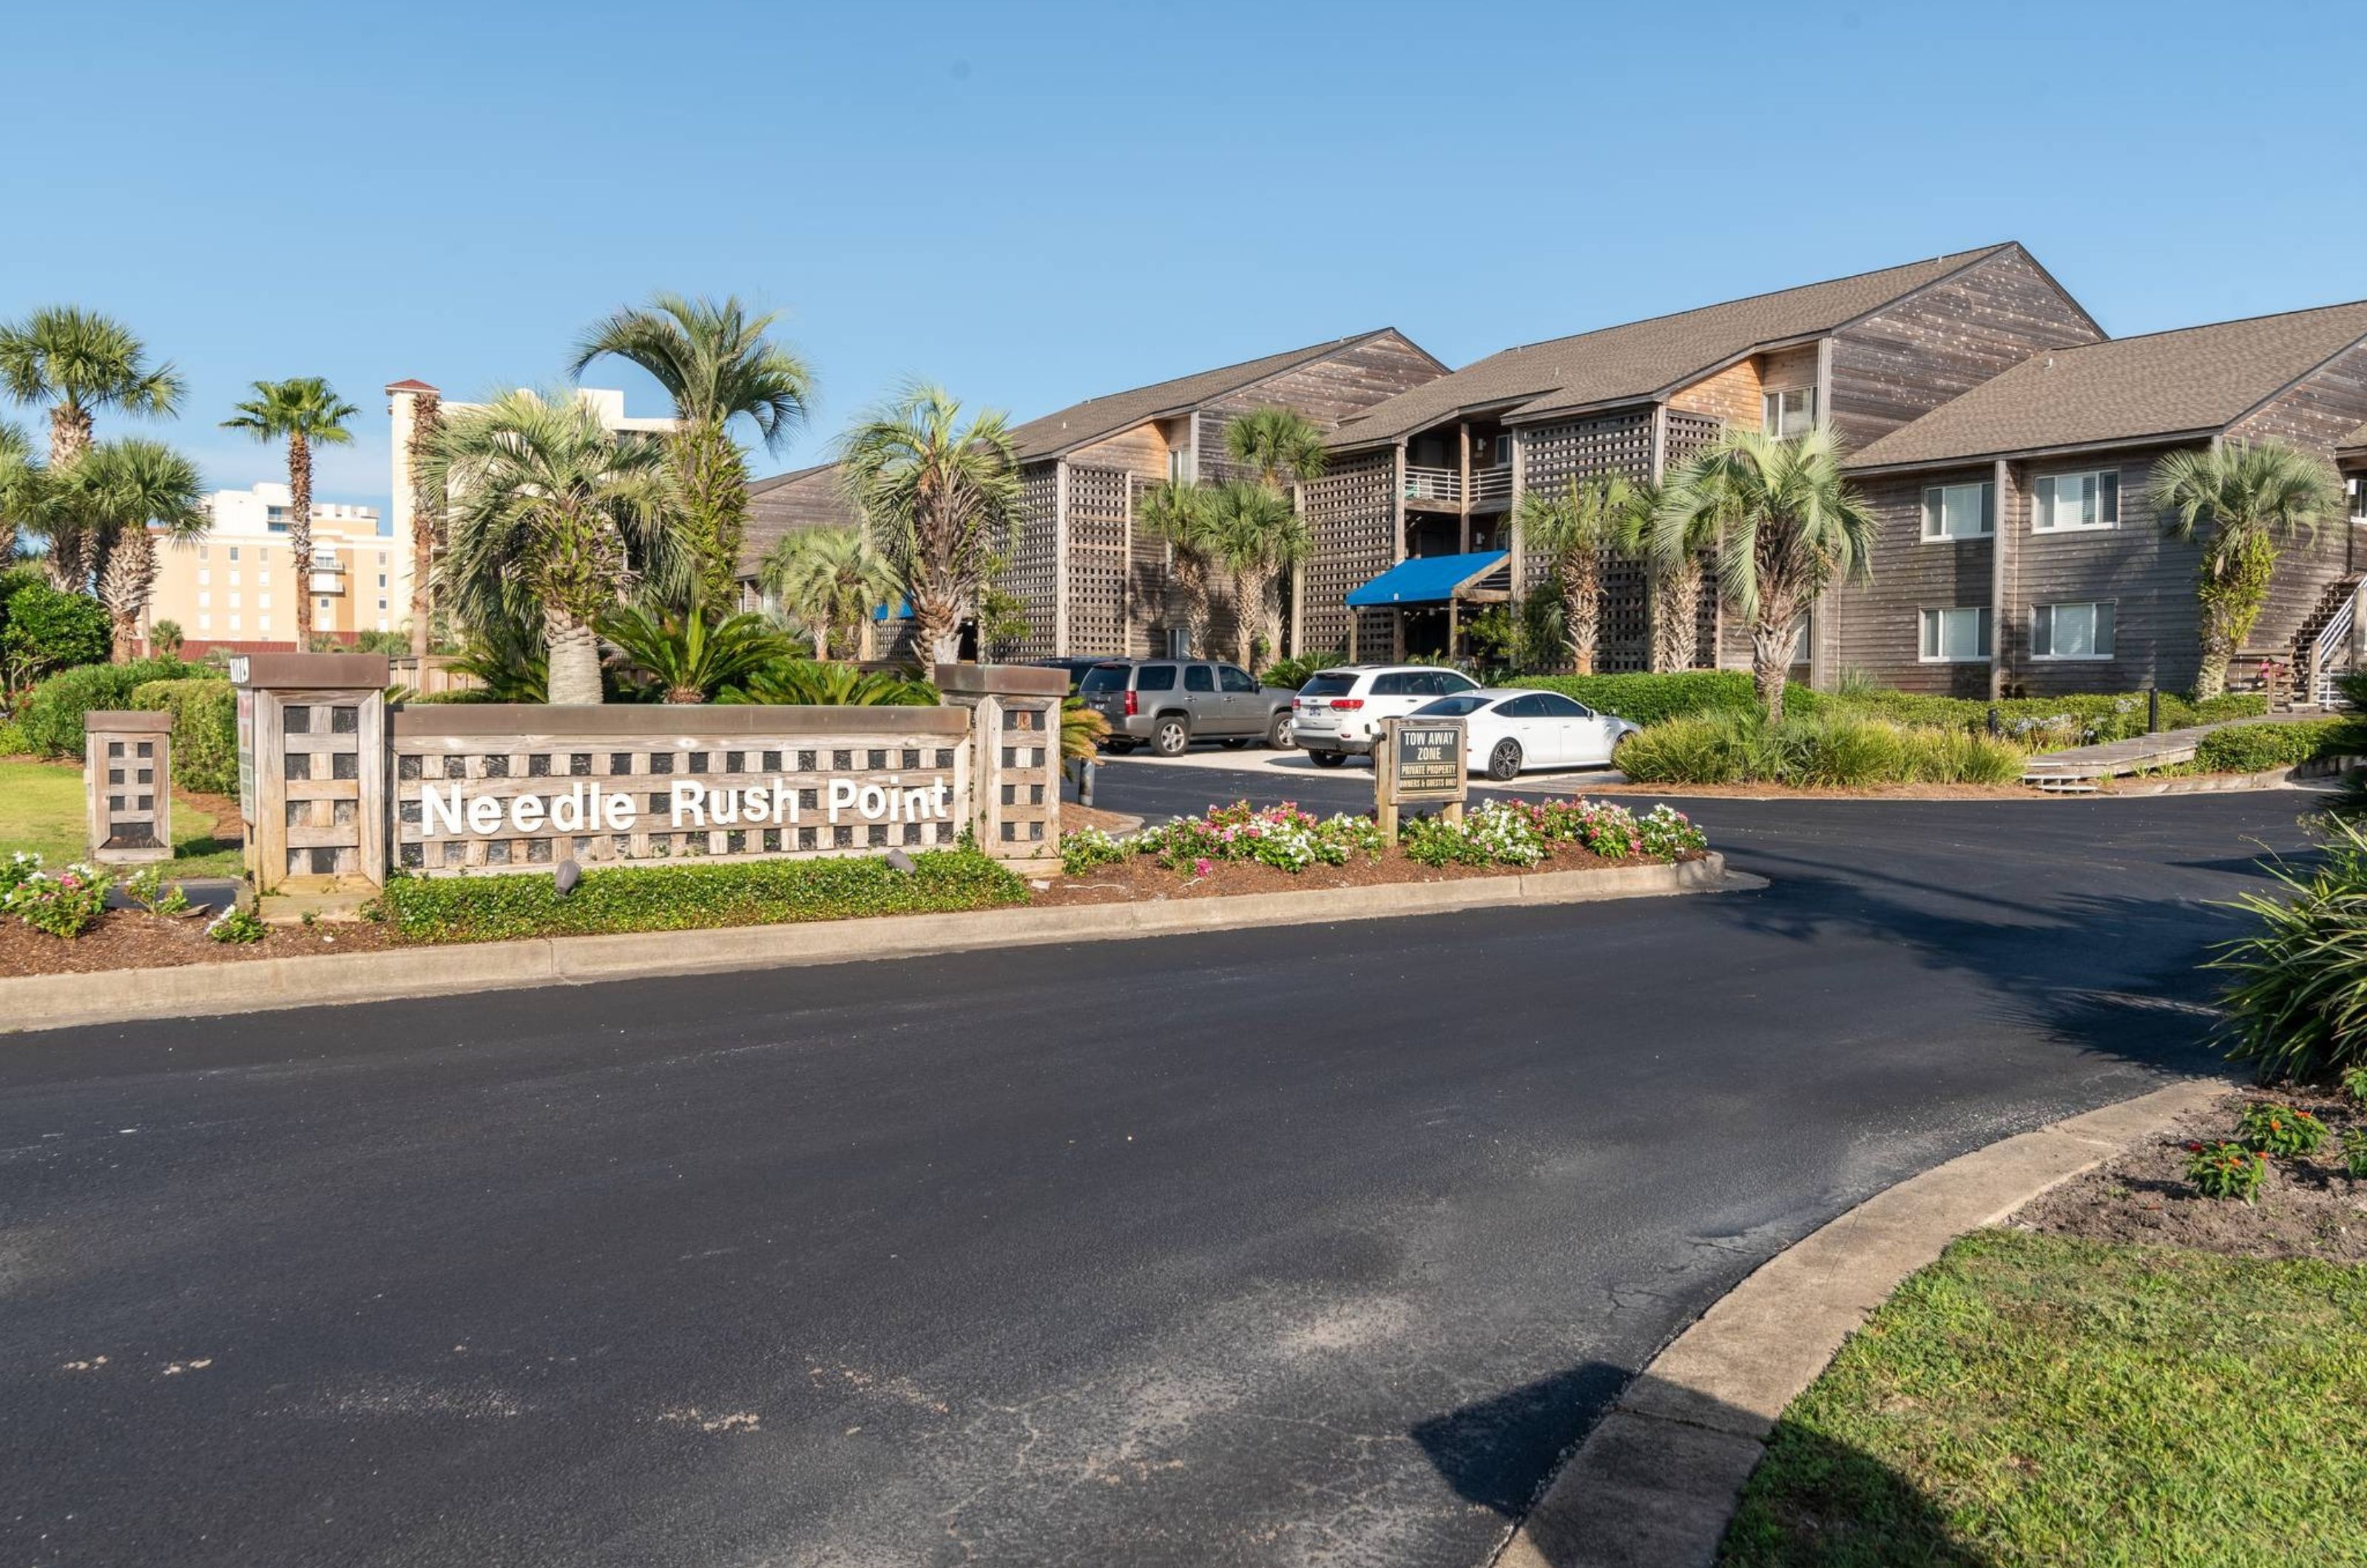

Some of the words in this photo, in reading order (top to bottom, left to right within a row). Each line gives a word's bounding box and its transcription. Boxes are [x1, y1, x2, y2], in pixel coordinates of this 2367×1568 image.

[1404, 731, 1426, 746] TOW
[1428, 731, 1454, 746] AWAY
[1417, 746, 1442, 760] ZONE
[1401, 765, 1425, 775] PRIVATE
[1426, 764, 1456, 774] PROPERTY
[421, 781, 637, 837] Needle
[671, 777, 800, 828] Rush
[828, 775, 948, 824] Point
